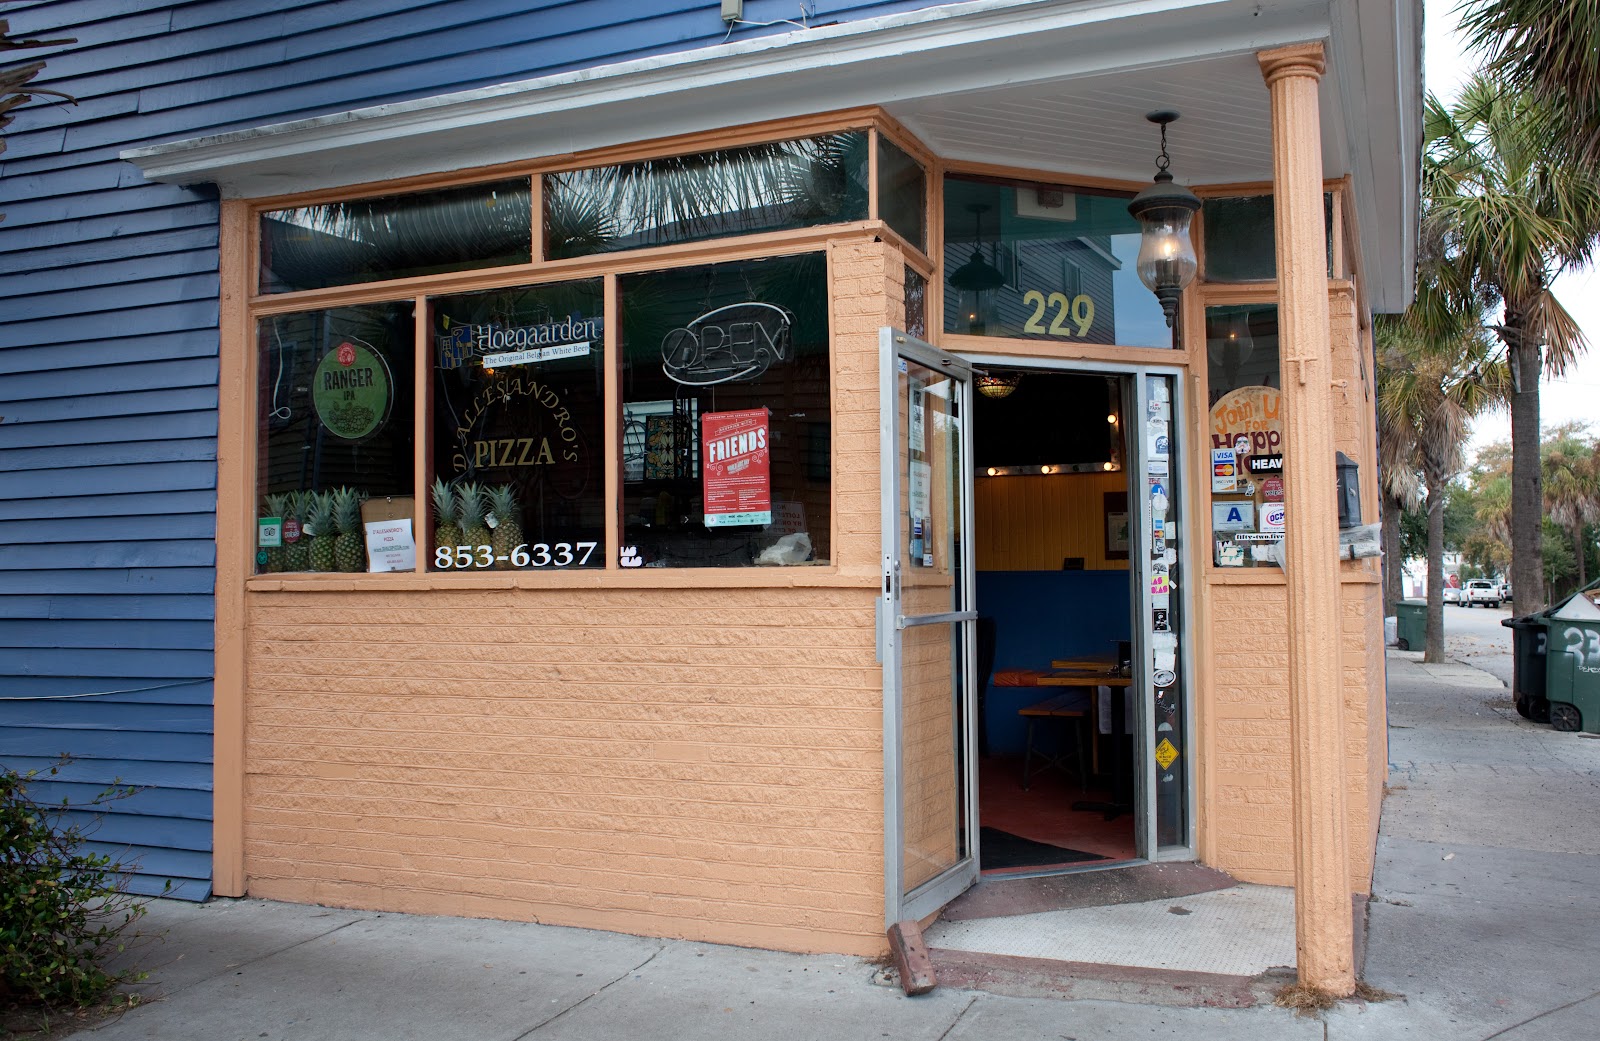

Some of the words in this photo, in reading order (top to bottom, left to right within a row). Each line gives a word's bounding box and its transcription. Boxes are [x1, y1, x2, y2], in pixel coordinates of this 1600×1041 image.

[1023, 290, 1095, 337] 229
[477, 315, 602, 351] Hoegaarden
[661, 319, 786, 370] OPEN
[485, 357, 497, 365] The
[498, 353, 525, 363] Original
[552, 347, 572, 355] White
[323, 367, 374, 391] RANGER
[343, 390, 356, 401] IPA
[1215, 400, 1253, 434] Join
[1245, 420, 1270, 431] FOR
[474, 437, 556, 468] PIZZA
[709, 428, 766, 463] FRIENDS
[1226, 507, 1243, 522] A
[434, 541, 598, 569] 853-6337
